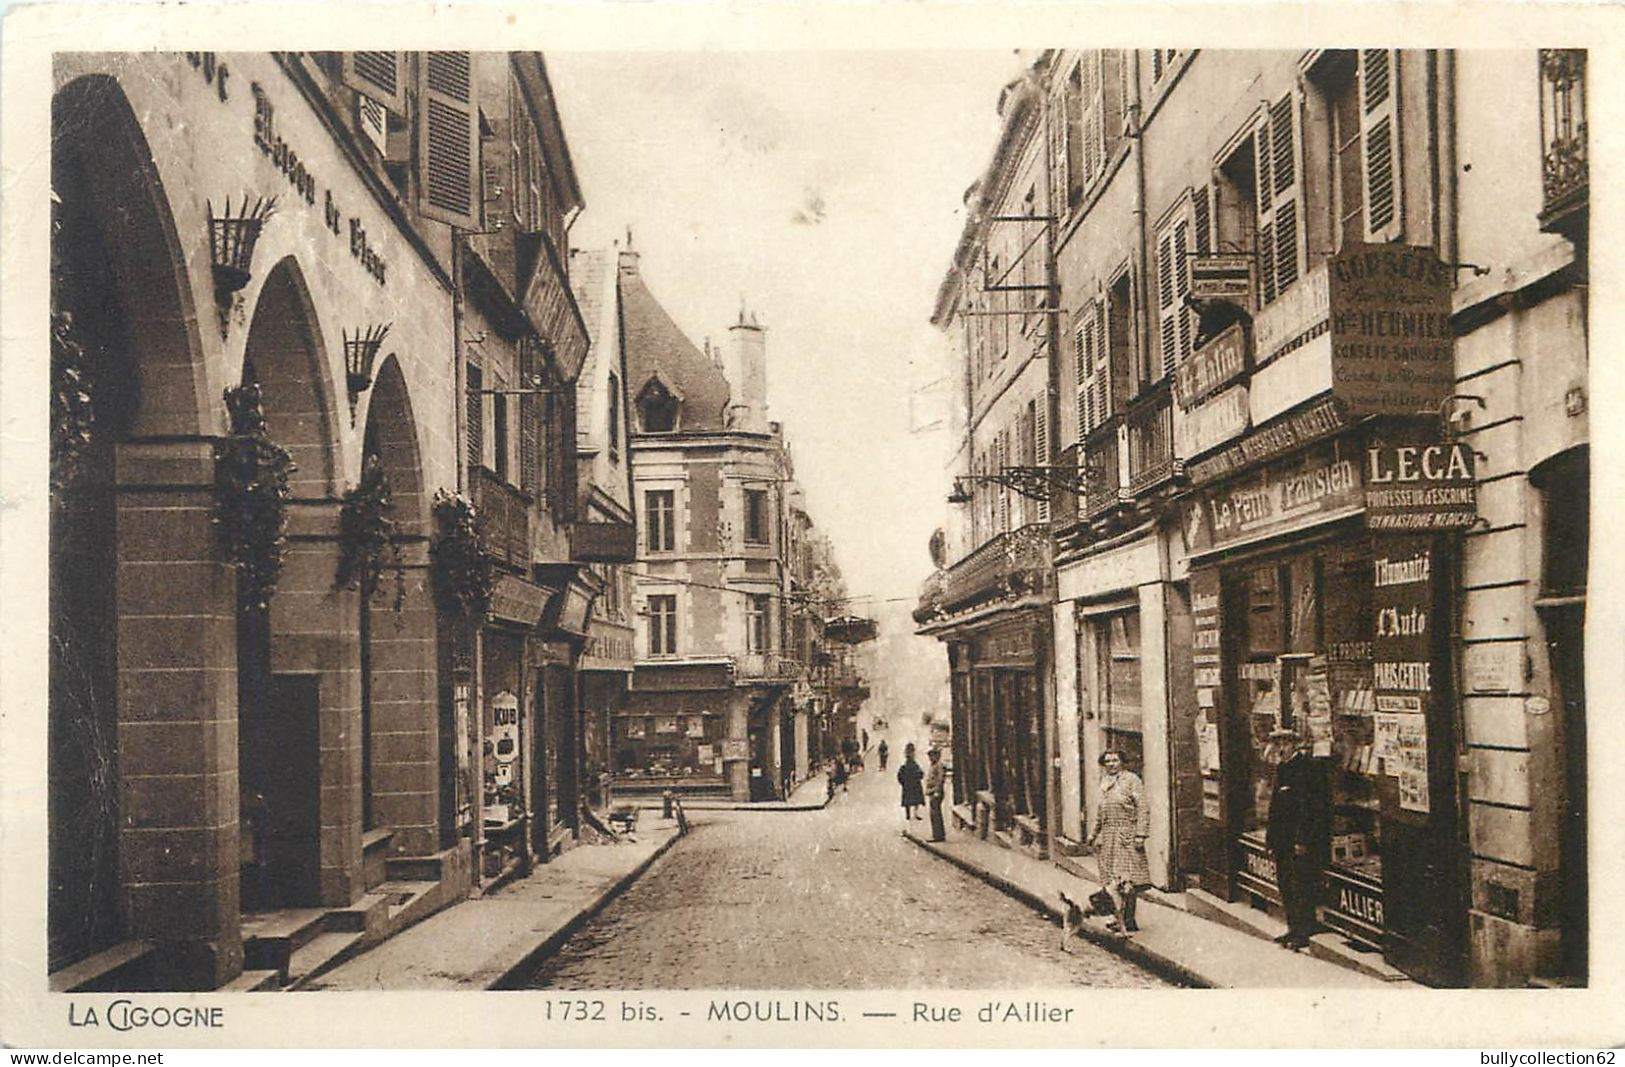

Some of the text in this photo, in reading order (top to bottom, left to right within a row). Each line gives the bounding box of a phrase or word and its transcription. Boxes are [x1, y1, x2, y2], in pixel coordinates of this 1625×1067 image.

[1368, 445, 1472, 482] LECA
[1210, 498, 1233, 531] Le
[1281, 459, 1354, 505] Parisien
[1366, 489, 1425, 508] PROFESSEUR
[1369, 512, 1434, 529] GYMNASTIQUE
[494, 707, 517, 728] KUB
[1340, 888, 1385, 926] ALLIER
